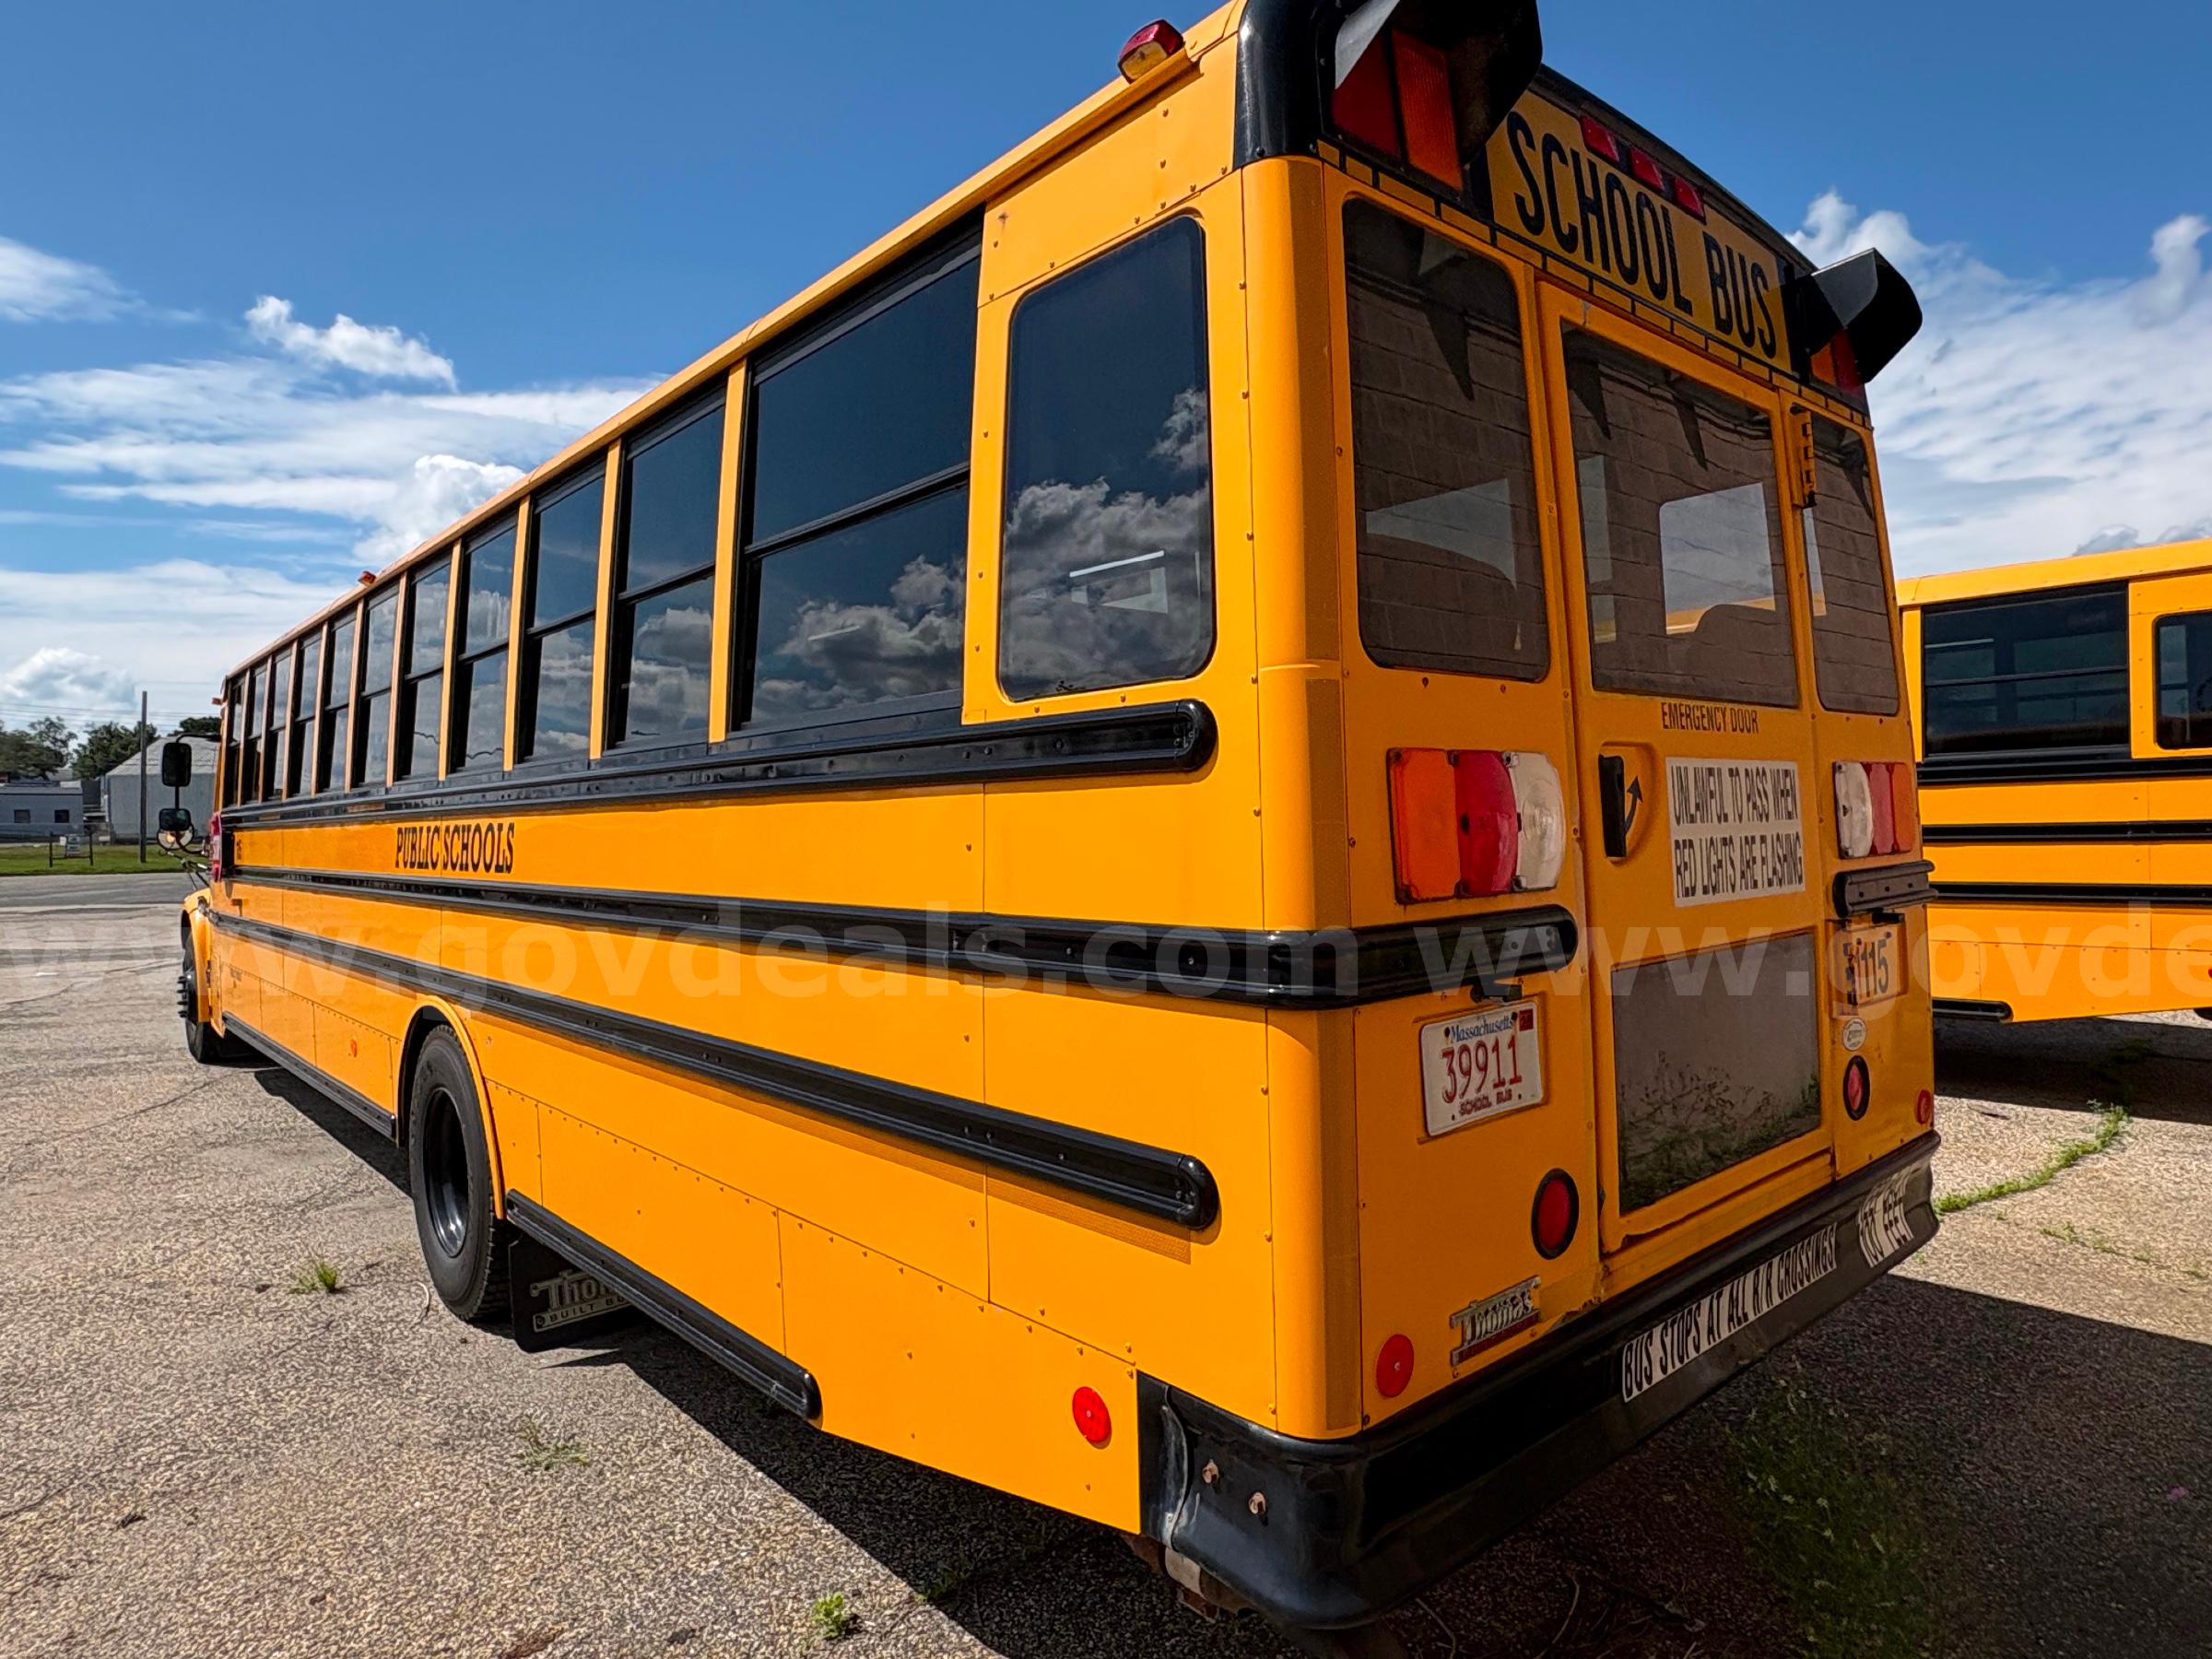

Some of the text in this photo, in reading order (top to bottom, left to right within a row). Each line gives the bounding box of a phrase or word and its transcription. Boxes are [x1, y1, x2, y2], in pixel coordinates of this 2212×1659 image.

[1507, 111, 1777, 359] SCHOOL BUS
[1661, 702, 1759, 734] EMERGENCY DOOR
[1671, 766, 1798, 826] UNLAWFUL TO PASS WHEN
[395, 822, 515, 875] PUBLIC SCHOOLS
[1675, 831, 1803, 898] RED LIGHTS ARE FLASHING
[1451, 1014, 1513, 1043] Massachusetts
[1441, 1035, 1523, 1104] 39911
[1459, 1088, 1512, 1116] SCHOOL BUS
[1624, 1223, 1836, 1399] BUS STOPS AT ALL R/R CROSSINGS
